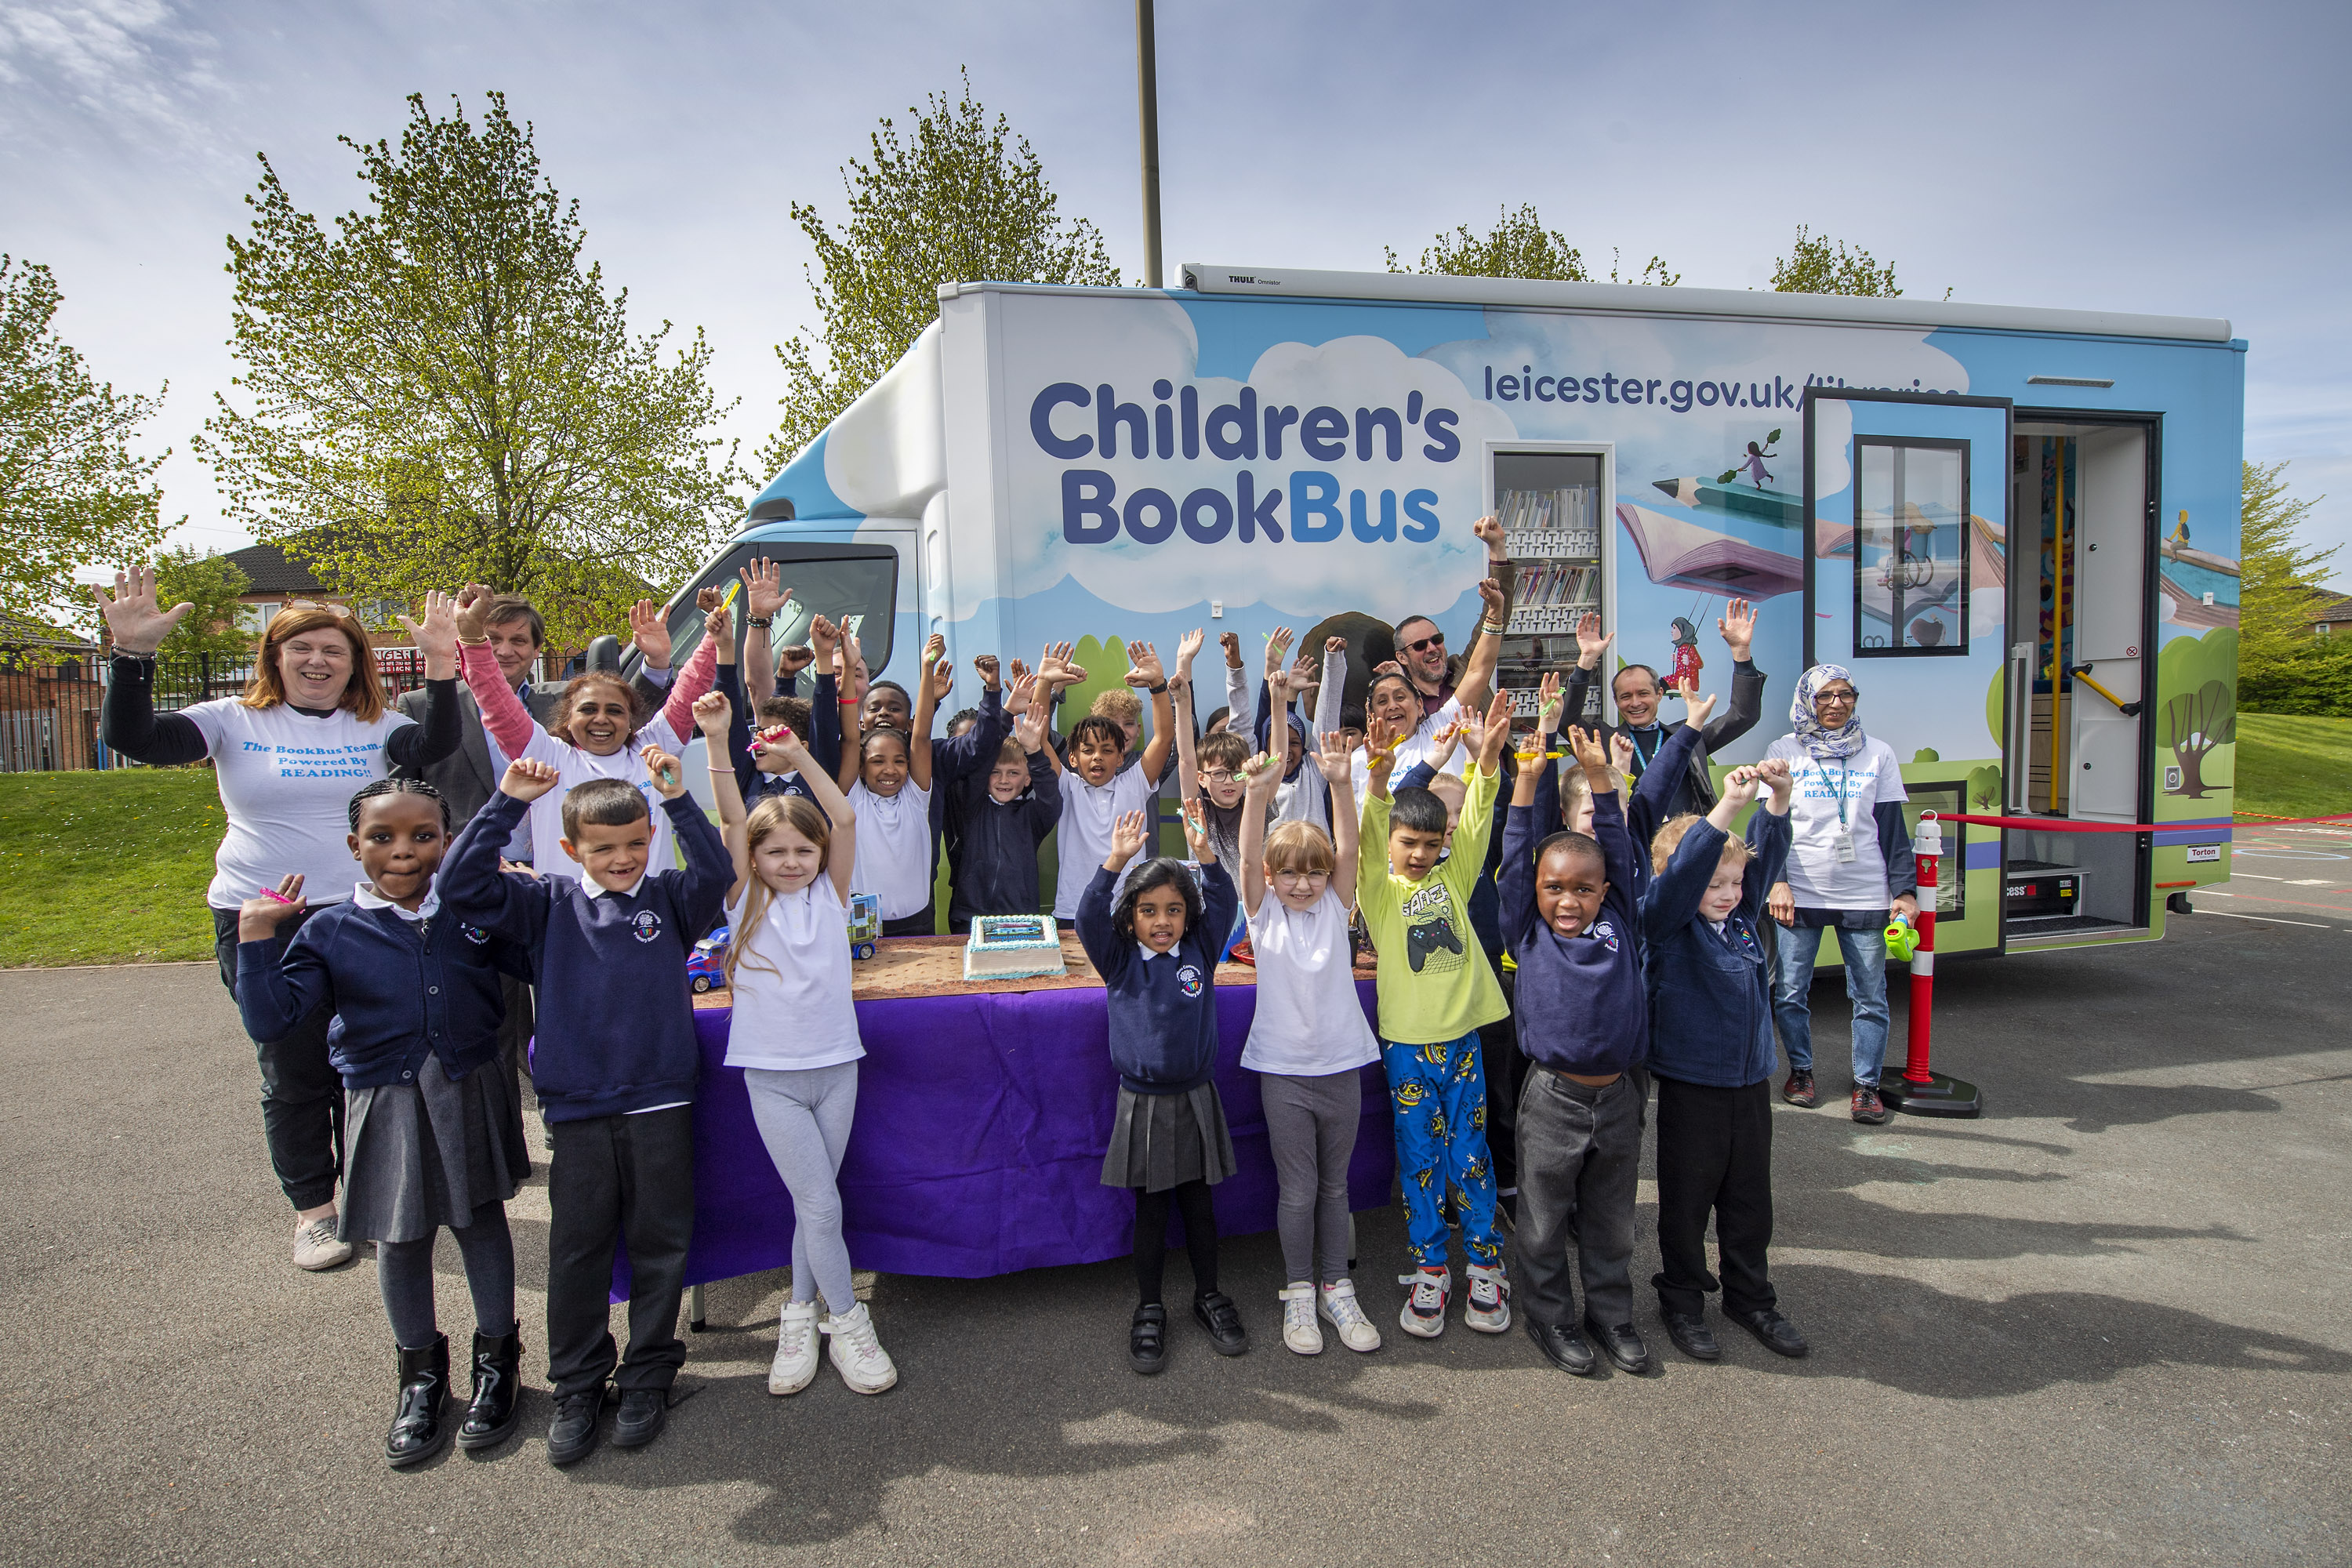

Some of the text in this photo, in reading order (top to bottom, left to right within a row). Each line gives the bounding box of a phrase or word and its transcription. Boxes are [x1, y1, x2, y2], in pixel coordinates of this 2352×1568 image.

[1229, 275, 1255, 284] THULE
[1485, 365, 1959, 413] leicester.gov.uk/
[1029, 378, 1461, 463] Children's
[1061, 469, 1441, 545] BookBus
[374, 649, 411, 660] NGER
[243, 741, 271, 753] The
[276, 746, 343, 755] BookBus
[278, 757, 368, 767] Powered By
[281, 768, 373, 778] READING!!
[633, 931, 647, 943] Primary
